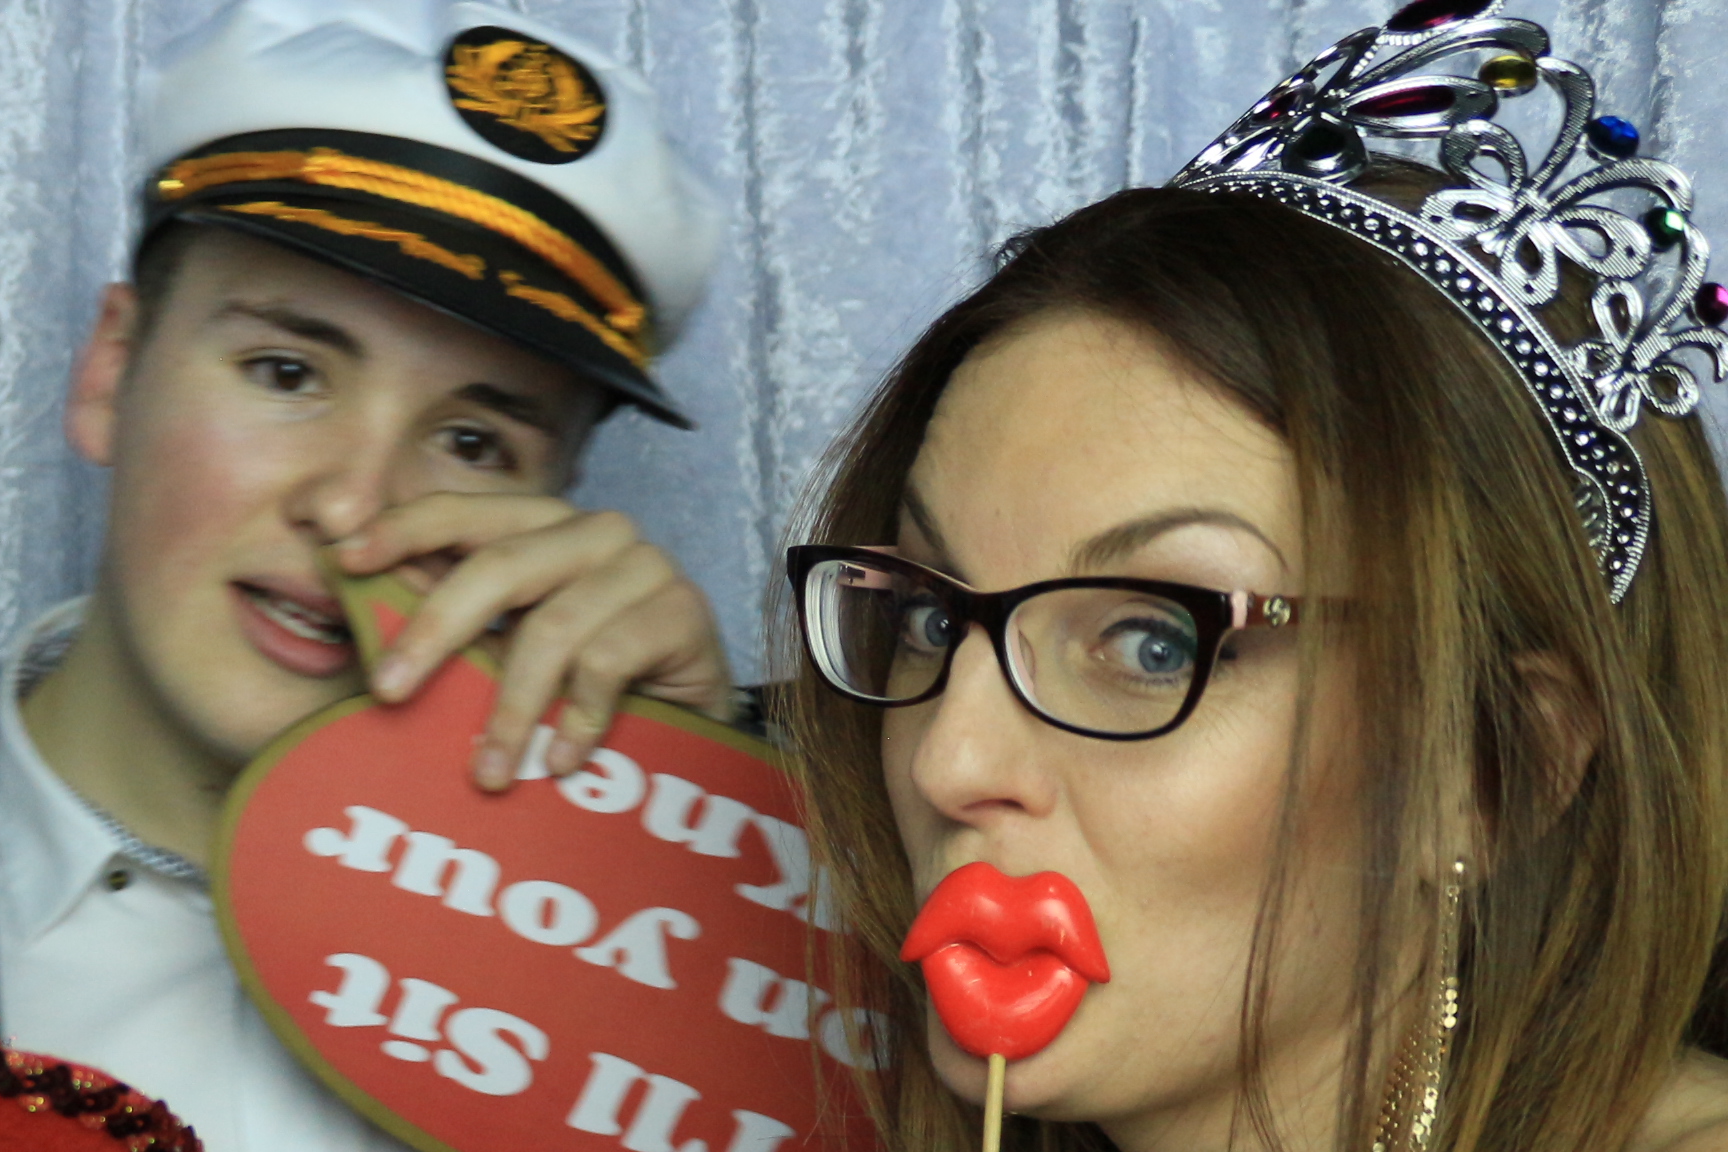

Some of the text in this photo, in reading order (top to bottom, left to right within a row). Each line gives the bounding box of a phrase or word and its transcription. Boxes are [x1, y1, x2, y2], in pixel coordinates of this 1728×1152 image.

[303, 804, 892, 1071] on your
[308, 952, 549, 1097] Sit
